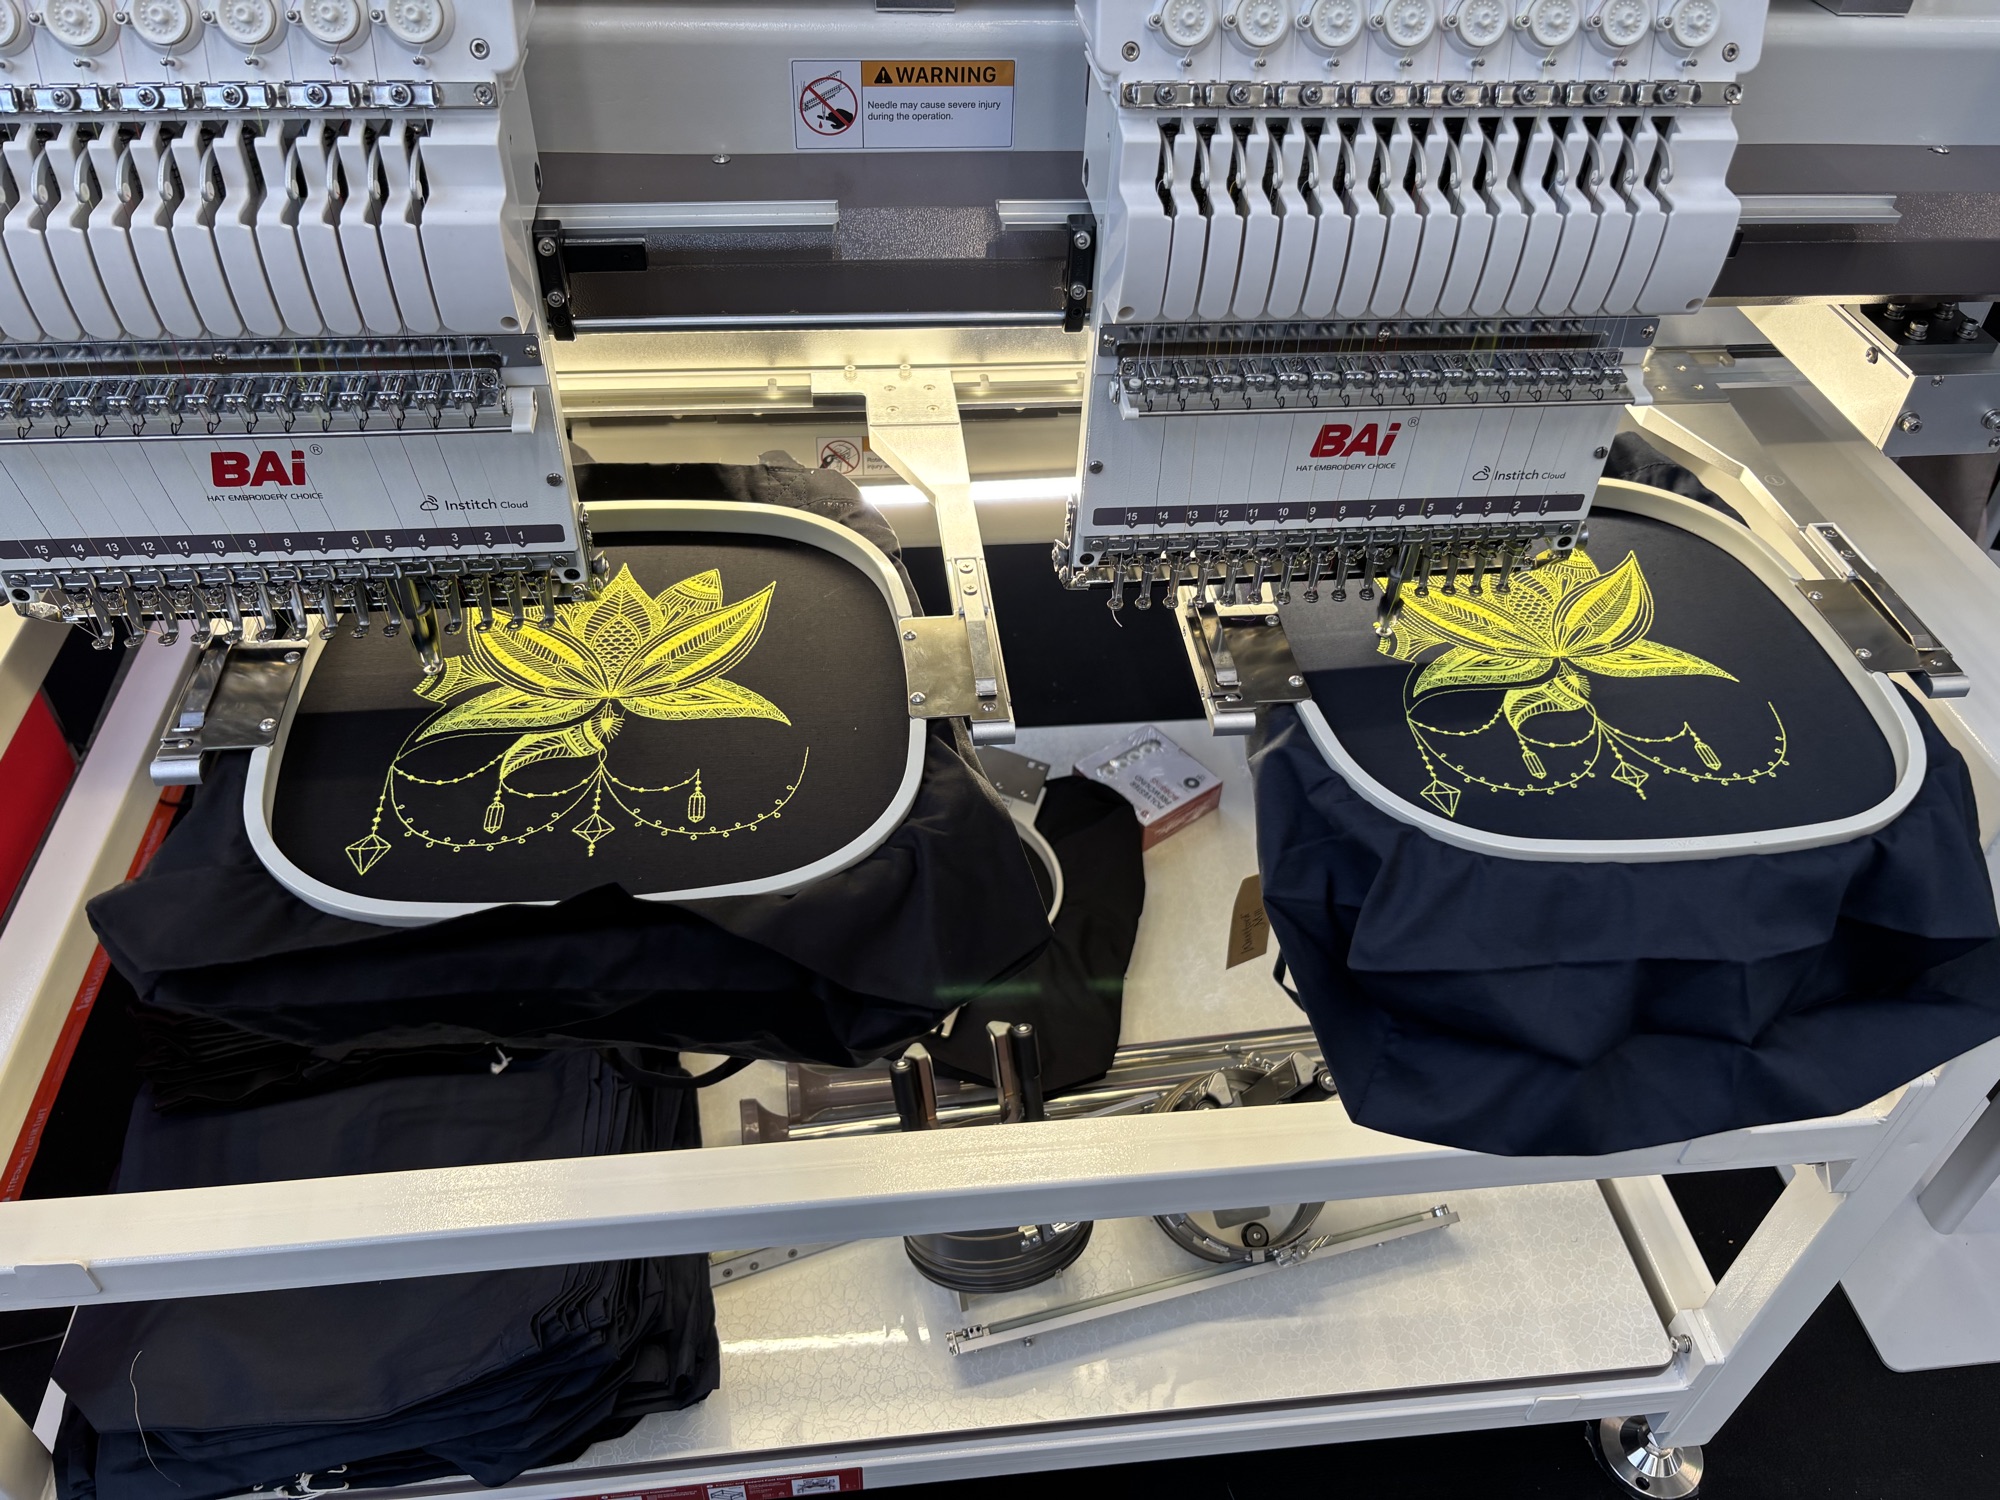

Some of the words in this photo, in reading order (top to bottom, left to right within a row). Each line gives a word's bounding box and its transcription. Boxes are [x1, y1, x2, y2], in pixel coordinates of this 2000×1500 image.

[896, 66, 997, 84] WARNING
[867, 100, 898, 109] Needle
[899, 102, 918, 111] may
[978, 100, 1001, 111] injury
[867, 112, 894, 122] during
[896, 112, 910, 121] the
[912, 112, 954, 122] operation.
[1309, 422, 1402, 458] BAi
[210, 450, 306, 488] BAi
[1295, 464, 1313, 472] HAT
[1314, 463, 1367, 471] EMBROIDERY
[1367, 462, 1397, 470] CHOICE
[1494, 469, 1540, 481] Institch
[1541, 472, 1567, 480] Cloud
[228, 493, 288, 501] EMBROIDERY
[290, 492, 324, 500] CHOICE
[444, 498, 498, 511] Institch
[500, 500, 529, 509] Cloud
[1126, 512, 1138, 521] 15
[1157, 511, 1169, 520] 14
[1187, 510, 1199, 519] 13
[1217, 509, 1230, 518] 12
[1248, 508, 1259, 517] 11
[1278, 507, 1289, 516] 10
[1309, 506, 1317, 515] 9
[1339, 505, 1347, 514] 8
[1369, 505, 1377, 513] 7
[1398, 504, 1406, 512] 6
[1427, 503, 1435, 512] 5
[1455, 502, 1464, 511] 4
[1485, 501, 1492, 510] 3
[1513, 500, 1521, 509] 2
[1543, 500, 1549, 508] 1
[34, 545, 49, 554] 15
[70, 543, 85, 553] 14
[105, 542, 120, 552] 13
[140, 541, 156, 551] 12
[176, 540, 190, 550] 11
[211, 539, 225, 549] 10
[248, 539, 257, 548] 9
[283, 538, 292, 547] 8
[317, 537, 325, 546] 7
[351, 536, 360, 545] 6
[384, 535, 393, 544] 5
[418, 534, 426, 543] 4
[451, 533, 459, 542] 3
[484, 532, 492, 541] 2
[517, 531, 524, 539] 1
